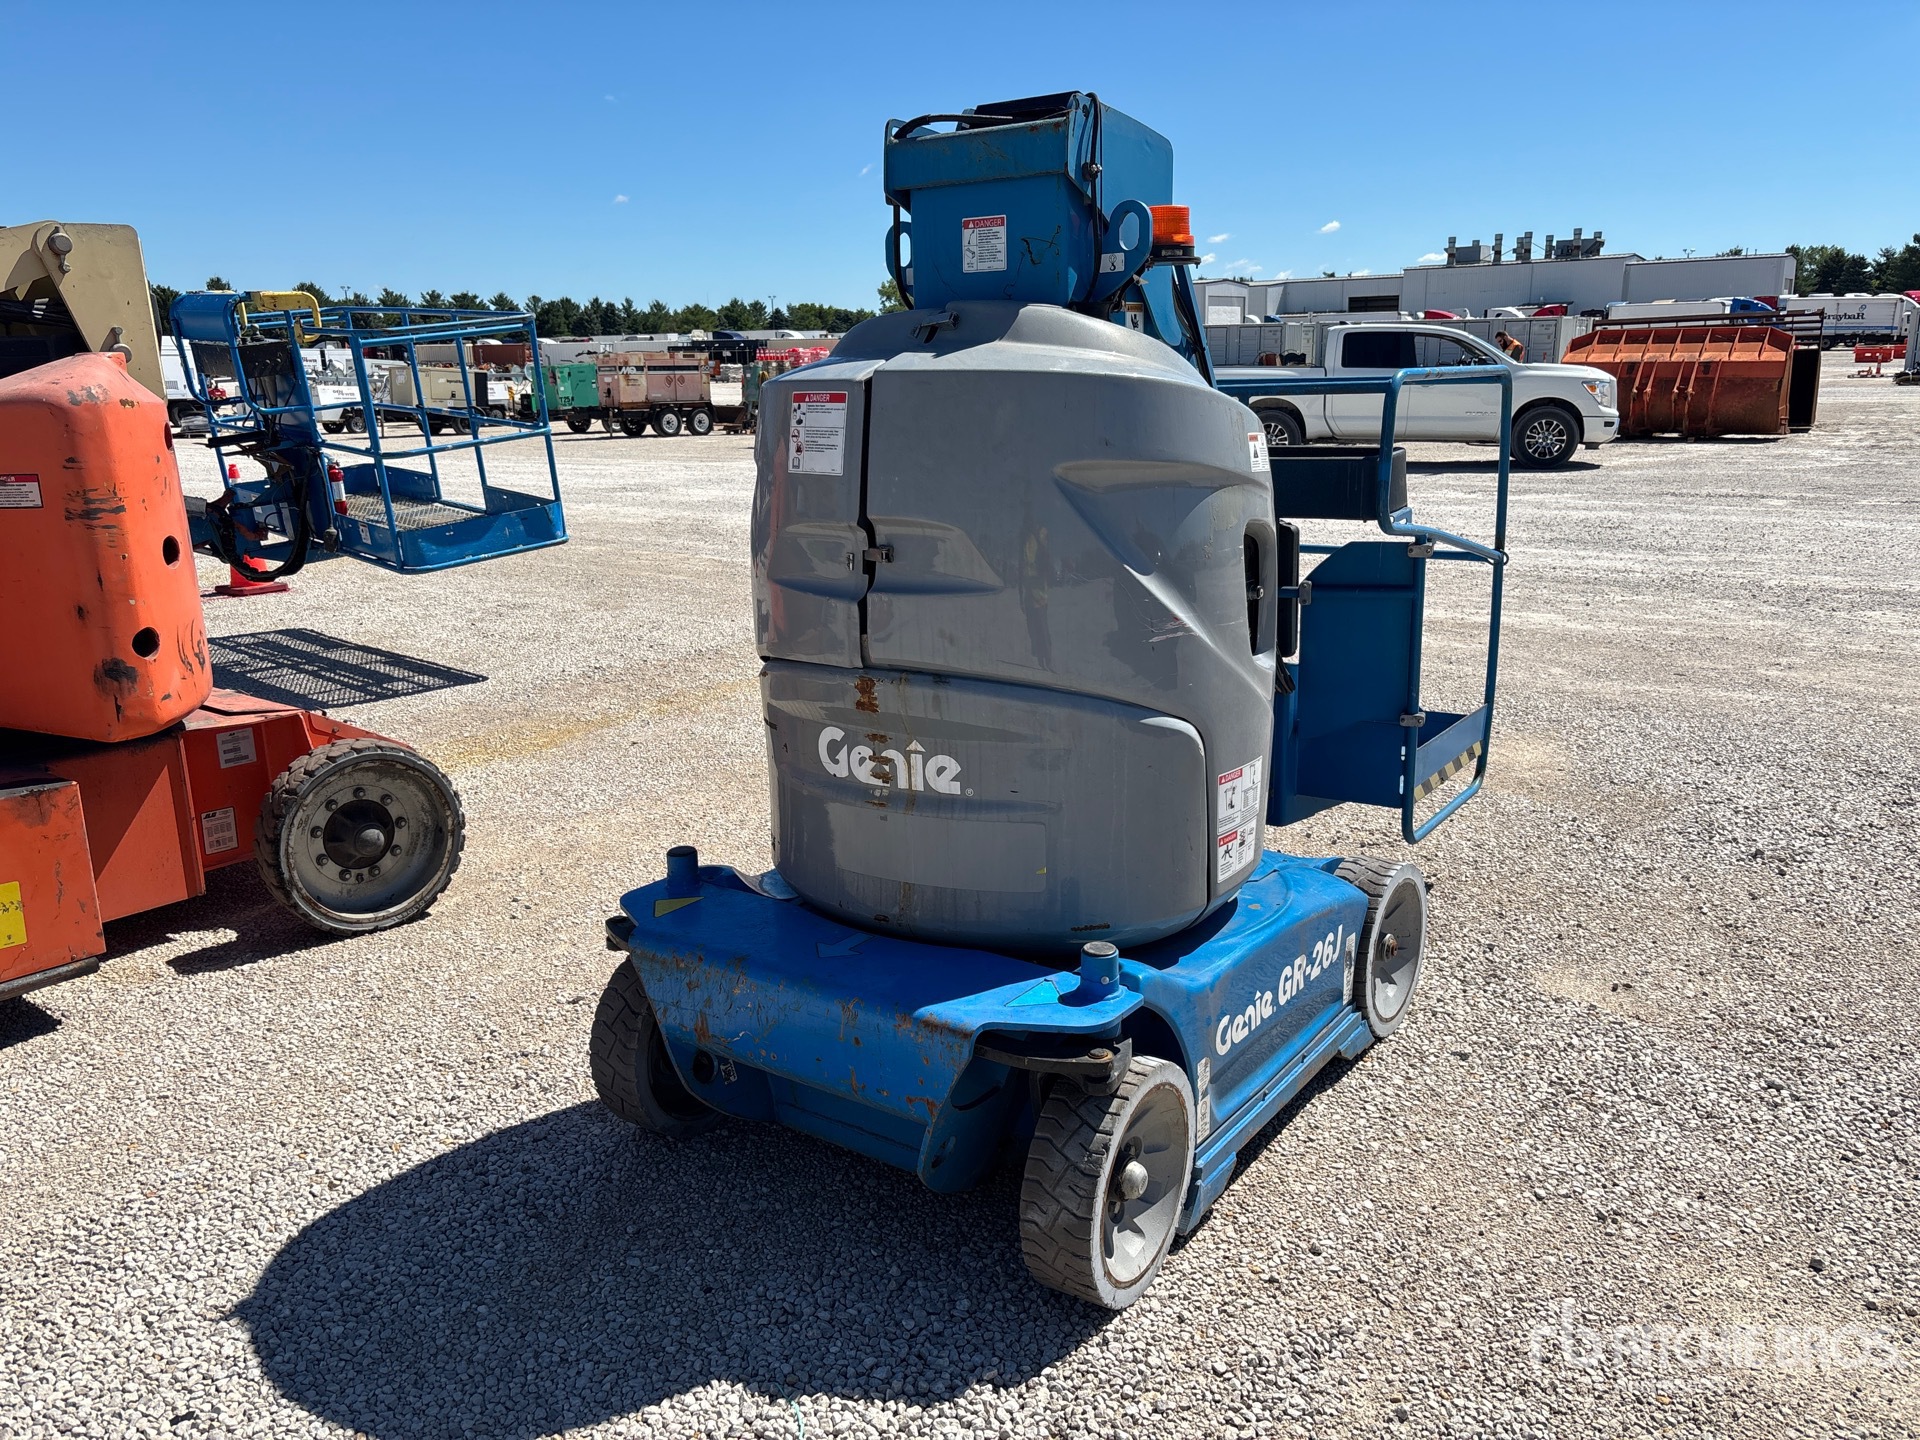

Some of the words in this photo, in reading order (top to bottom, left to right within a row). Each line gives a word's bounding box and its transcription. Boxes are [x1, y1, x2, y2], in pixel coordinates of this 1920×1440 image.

[974, 218, 1002, 228] DANGER
[809, 394, 830, 402] DANGER
[818, 726, 962, 795] Genie
[1215, 990, 1273, 1056] Genie
[1278, 924, 1343, 1006] GR-26J
